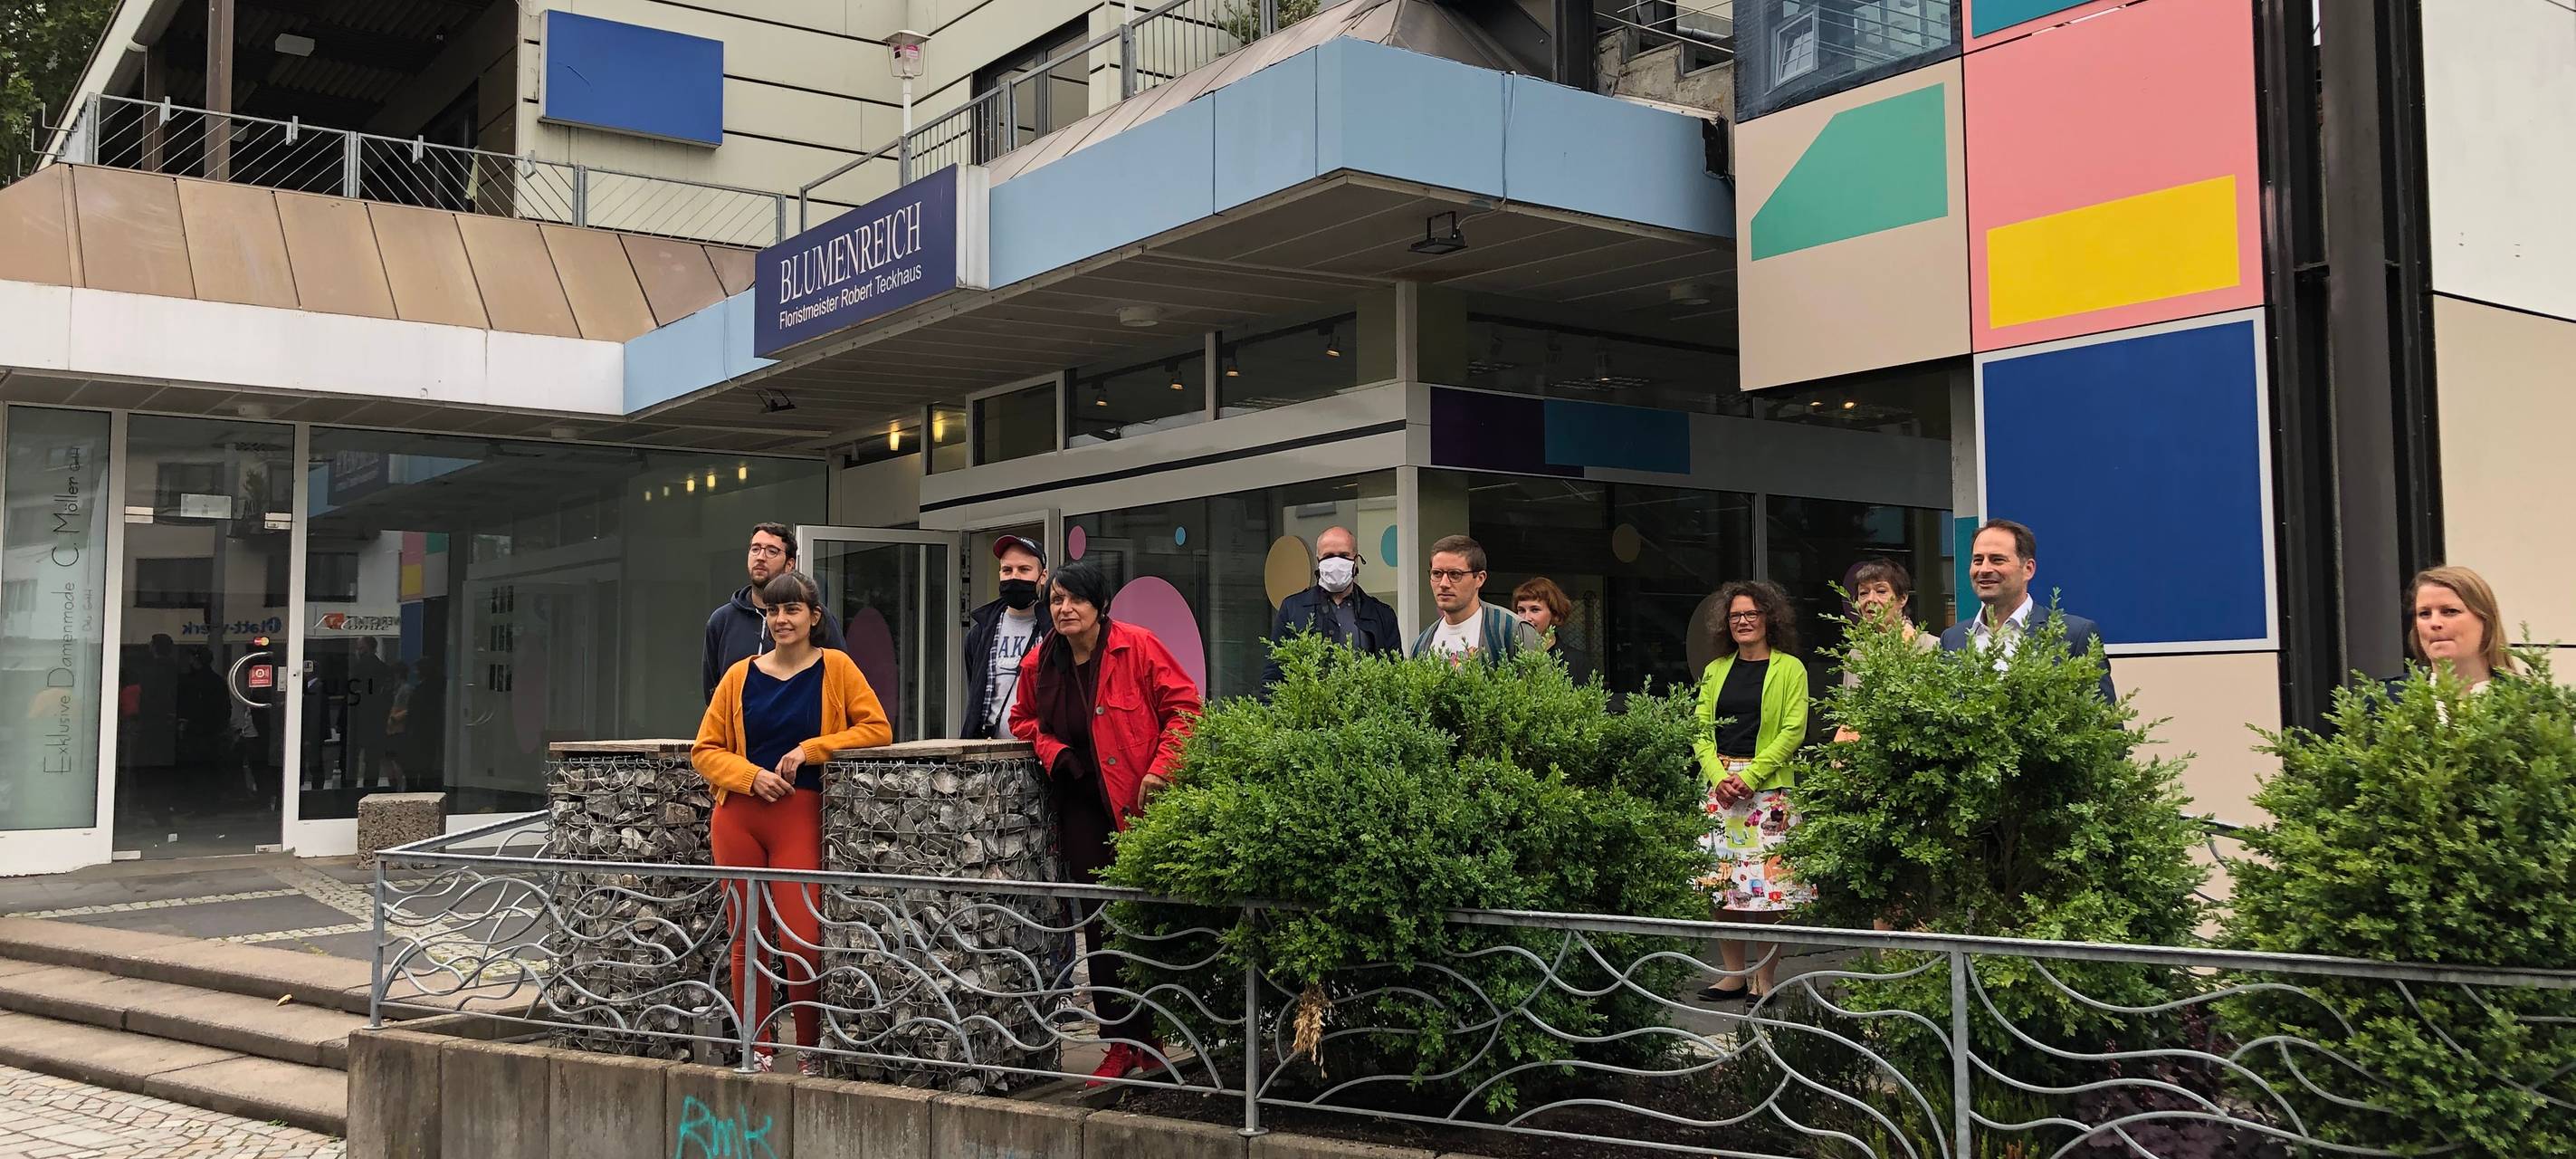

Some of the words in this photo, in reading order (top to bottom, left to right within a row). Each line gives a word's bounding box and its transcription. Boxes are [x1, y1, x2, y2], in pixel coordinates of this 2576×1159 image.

[779, 201, 922, 305] BLUMENREICH
[778, 295, 840, 330] Floristmeister
[840, 278, 873, 309] Robert
[874, 263, 923, 293] Teckhaus
[52, 476, 81, 532] Möller
[47, 581, 75, 687] Damenmode
[43, 694, 72, 775] Exklusive
